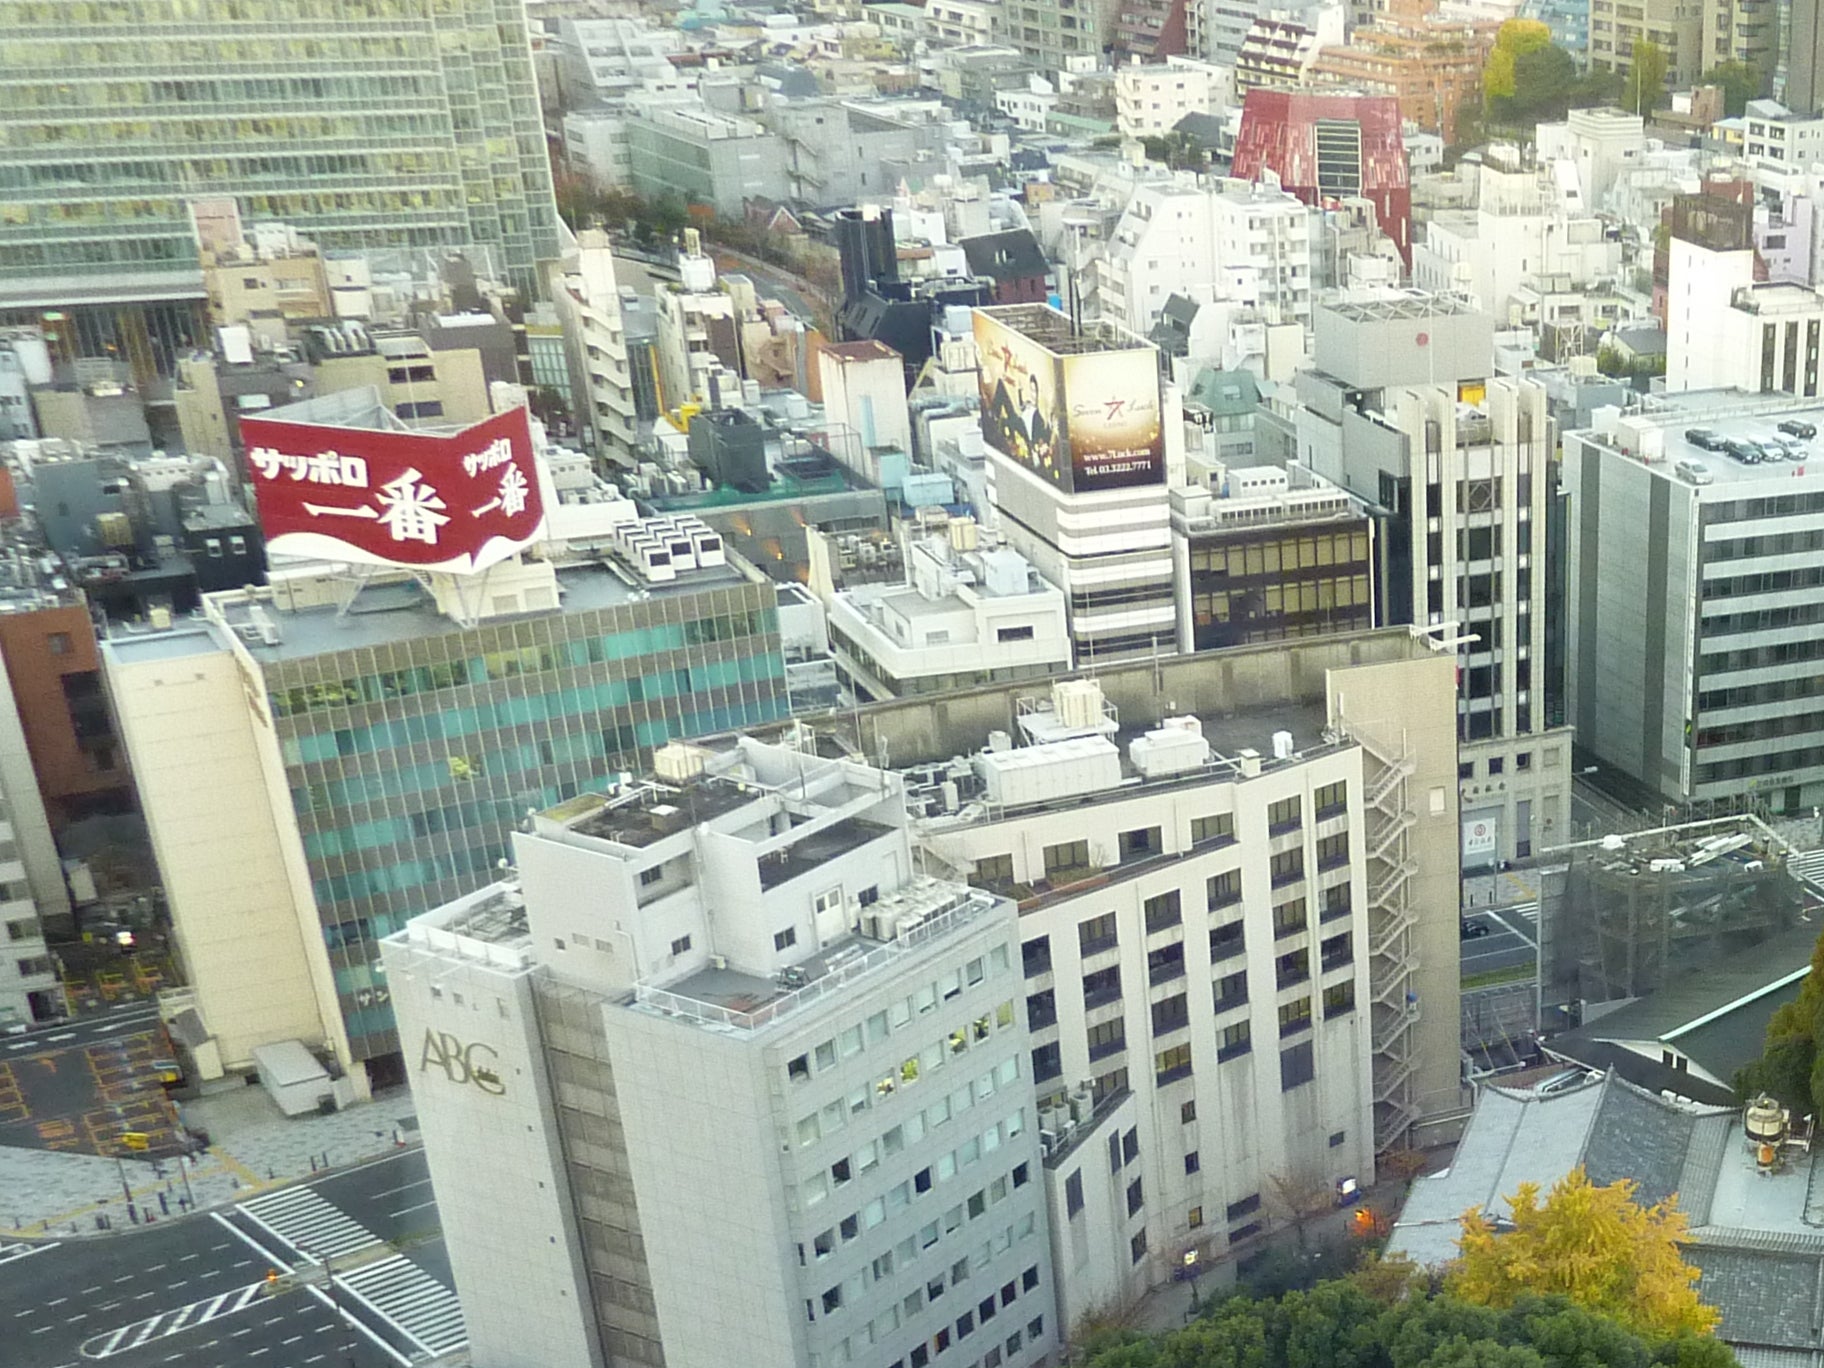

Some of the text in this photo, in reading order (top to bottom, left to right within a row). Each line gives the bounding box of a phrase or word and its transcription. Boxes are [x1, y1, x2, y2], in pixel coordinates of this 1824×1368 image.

[250, 447, 369, 488] サッポロ
[463, 438, 513, 478] サッポロ
[303, 467, 452, 544] 一番
[471, 462, 529, 518] 一番
